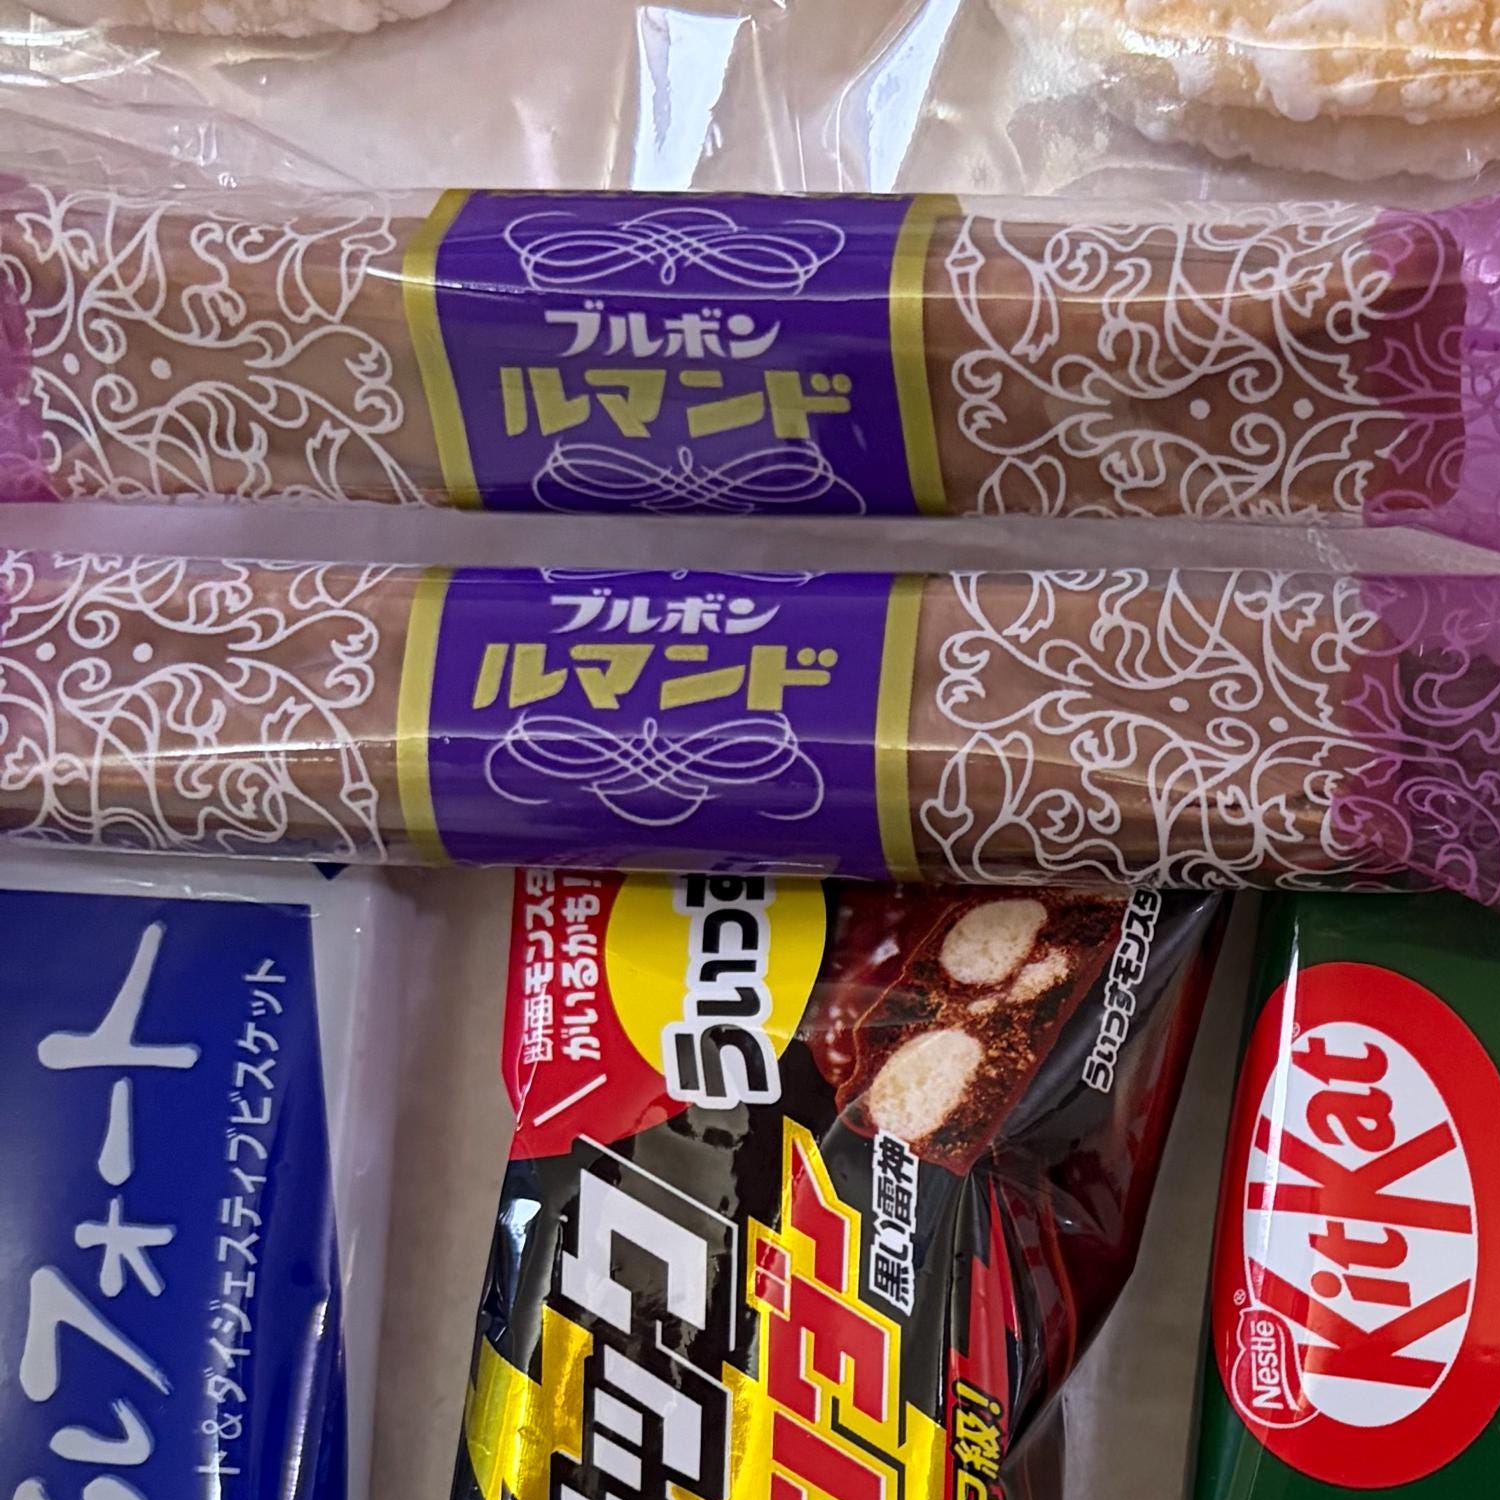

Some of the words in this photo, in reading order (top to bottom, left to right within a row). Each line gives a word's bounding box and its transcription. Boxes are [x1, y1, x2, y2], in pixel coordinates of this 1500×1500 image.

[544, 300, 781, 358] ブルボン
[502, 367, 853, 439] ルマンド
[549, 592, 781, 634] ブルボン
[472, 643, 838, 711] ルマンド
[872, 1133, 919, 1313] 黒い雷神
[1247, 1037, 1474, 1390] KitKat
